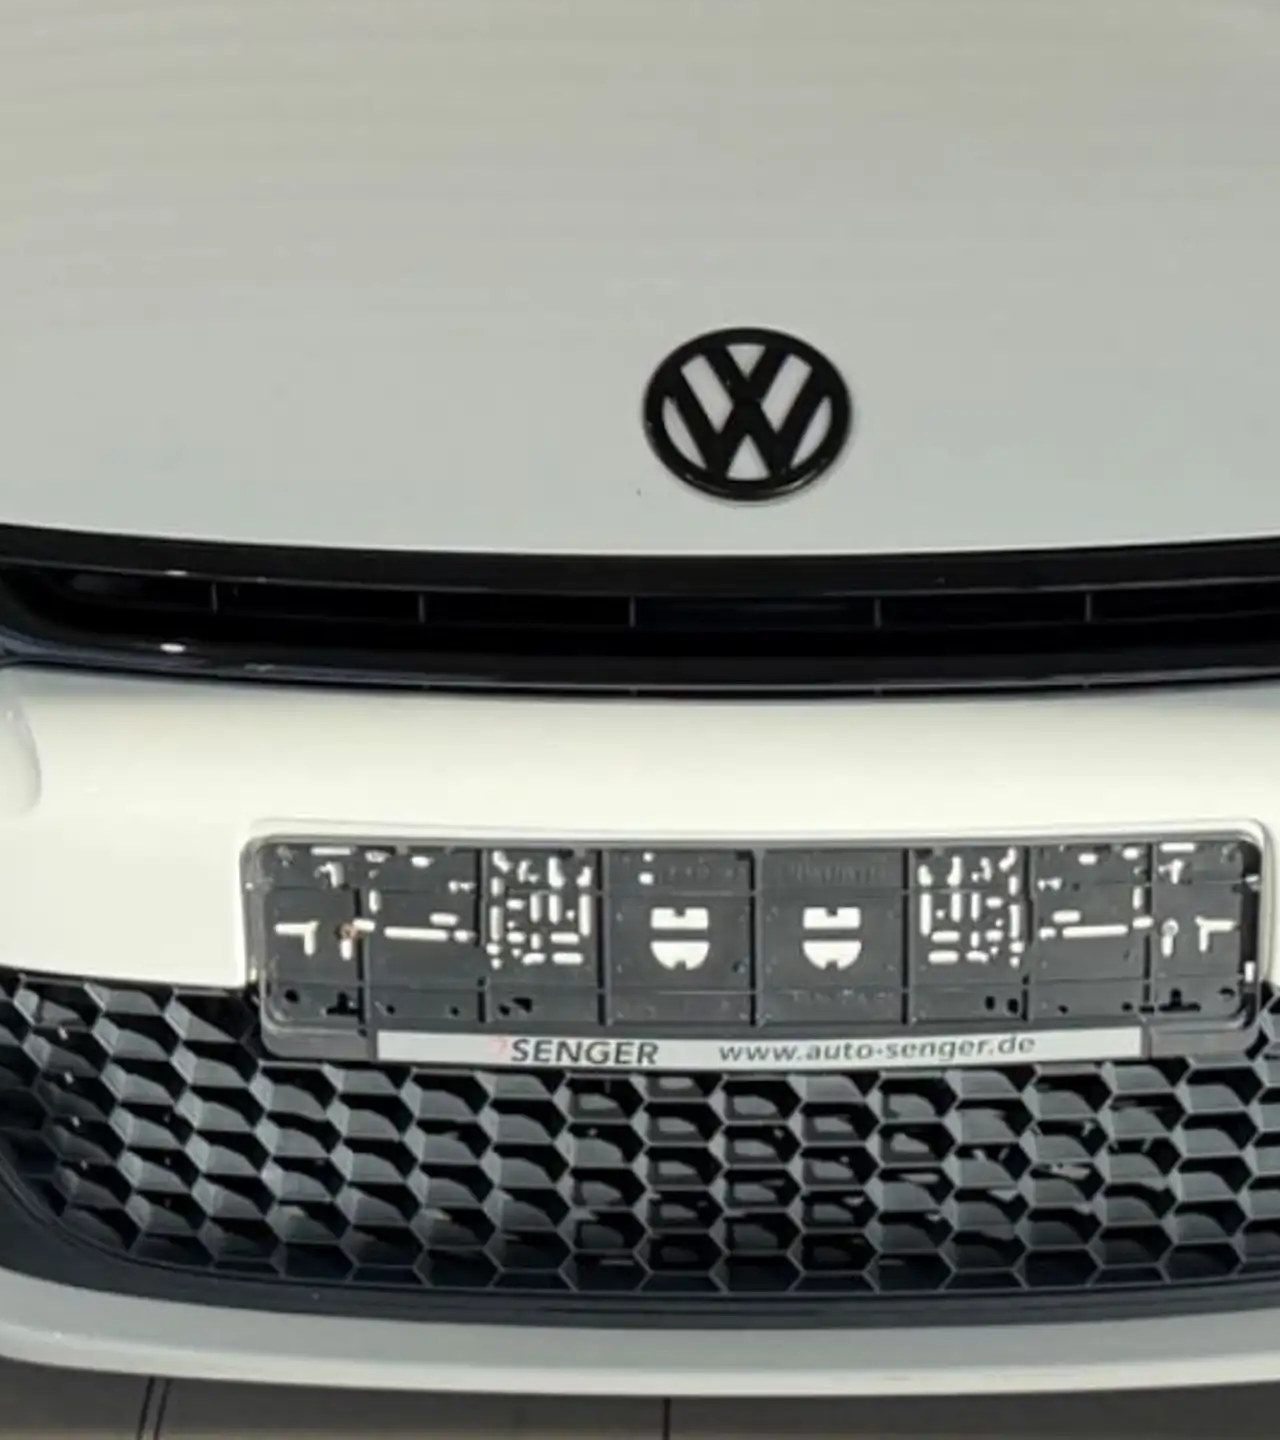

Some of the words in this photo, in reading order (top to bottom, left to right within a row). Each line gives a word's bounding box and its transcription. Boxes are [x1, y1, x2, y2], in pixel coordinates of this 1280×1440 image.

[645, 328, 850, 500] VW
[510, 1037, 660, 1066] SENGER
[719, 1033, 1036, 1062] www.auto-senger.de
